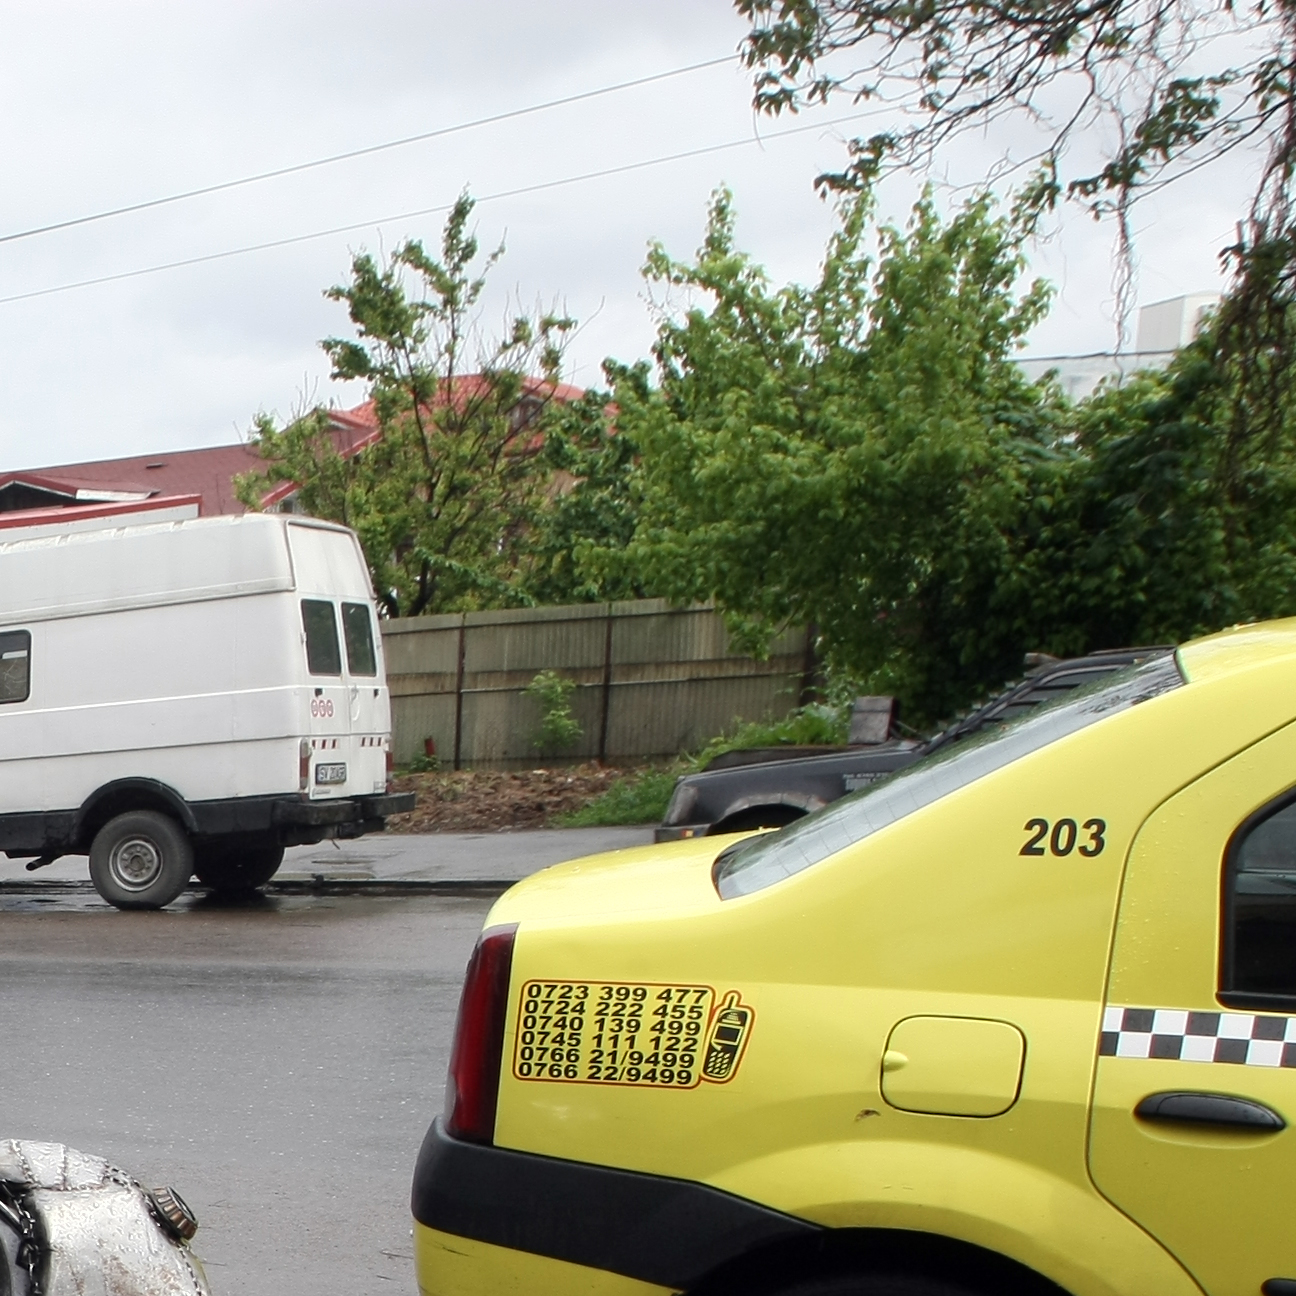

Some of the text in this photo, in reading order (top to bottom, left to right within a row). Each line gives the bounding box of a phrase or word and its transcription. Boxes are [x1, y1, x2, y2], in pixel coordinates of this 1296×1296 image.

[1018, 818, 1106, 858] 203
[528, 984, 707, 1004] 0723 399 477
[525, 1000, 702, 1019] 0724 222 455
[523, 1016, 700, 1035] 0740 139 499
[521, 1031, 697, 1052] 0745 111 122
[520, 1047, 694, 1068] 0766 21/9499
[519, 1063, 692, 1085] 0766 22/9499
